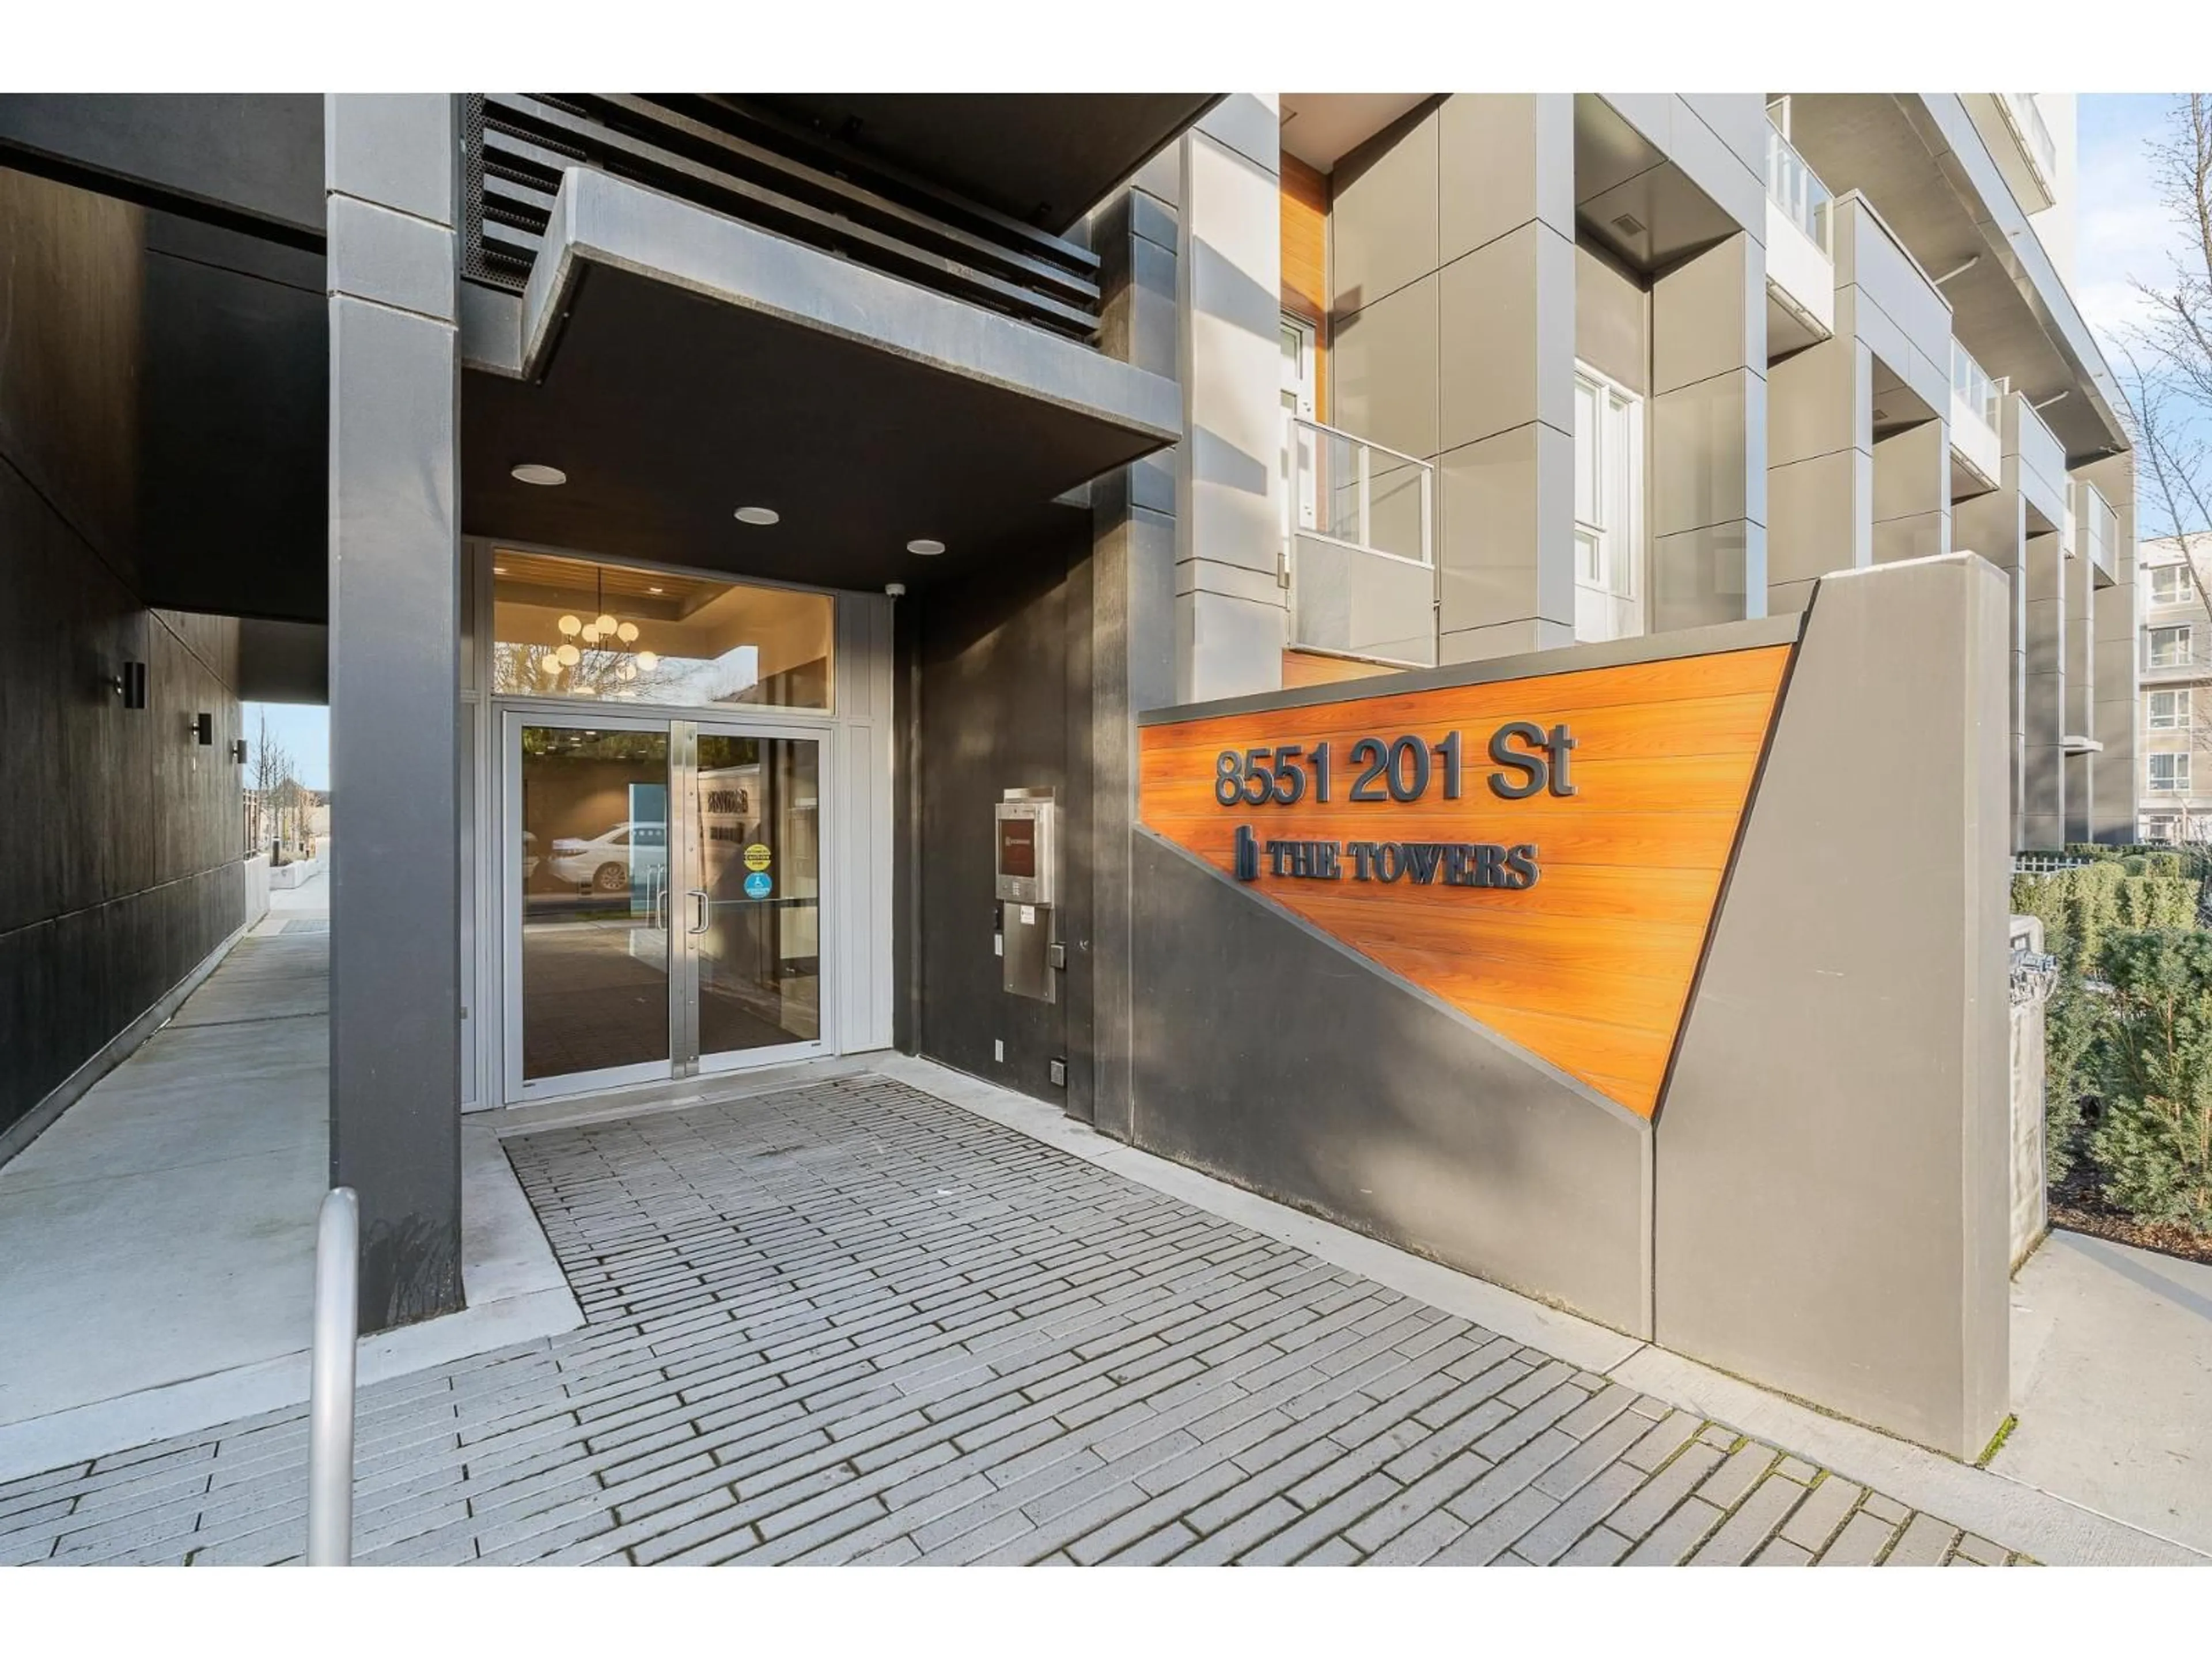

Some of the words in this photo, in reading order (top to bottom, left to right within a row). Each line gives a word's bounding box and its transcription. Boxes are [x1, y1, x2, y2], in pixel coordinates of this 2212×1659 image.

[1215, 742, 1330, 805] 8551
[1349, 730, 1461, 802] 201
[1487, 721, 1579, 800] St
[1267, 840, 1342, 880] THE
[1347, 840, 1540, 889] TOWERS
